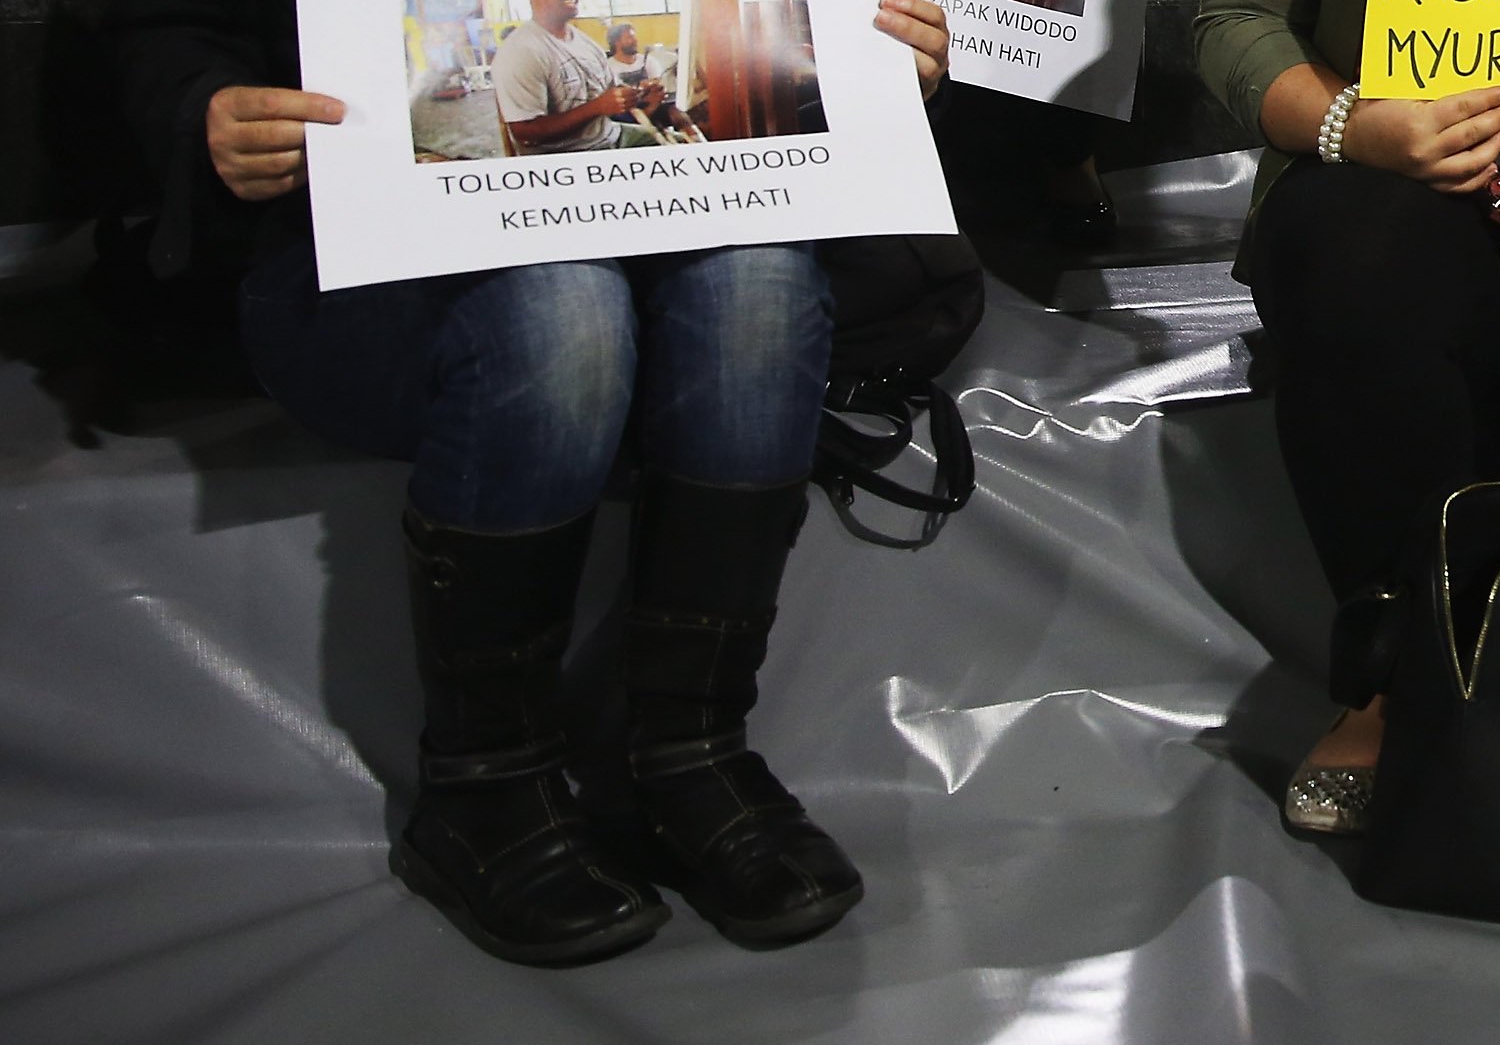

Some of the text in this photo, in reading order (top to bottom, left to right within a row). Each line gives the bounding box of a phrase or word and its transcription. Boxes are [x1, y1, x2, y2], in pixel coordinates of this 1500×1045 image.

[996, 7, 1077, 42] WIDODO
[1000, 43, 1041, 69] HATI
[437, 145, 831, 195] TOLONG BAPAK WIDODO
[501, 187, 792, 231] KEMURAHAN HATI
